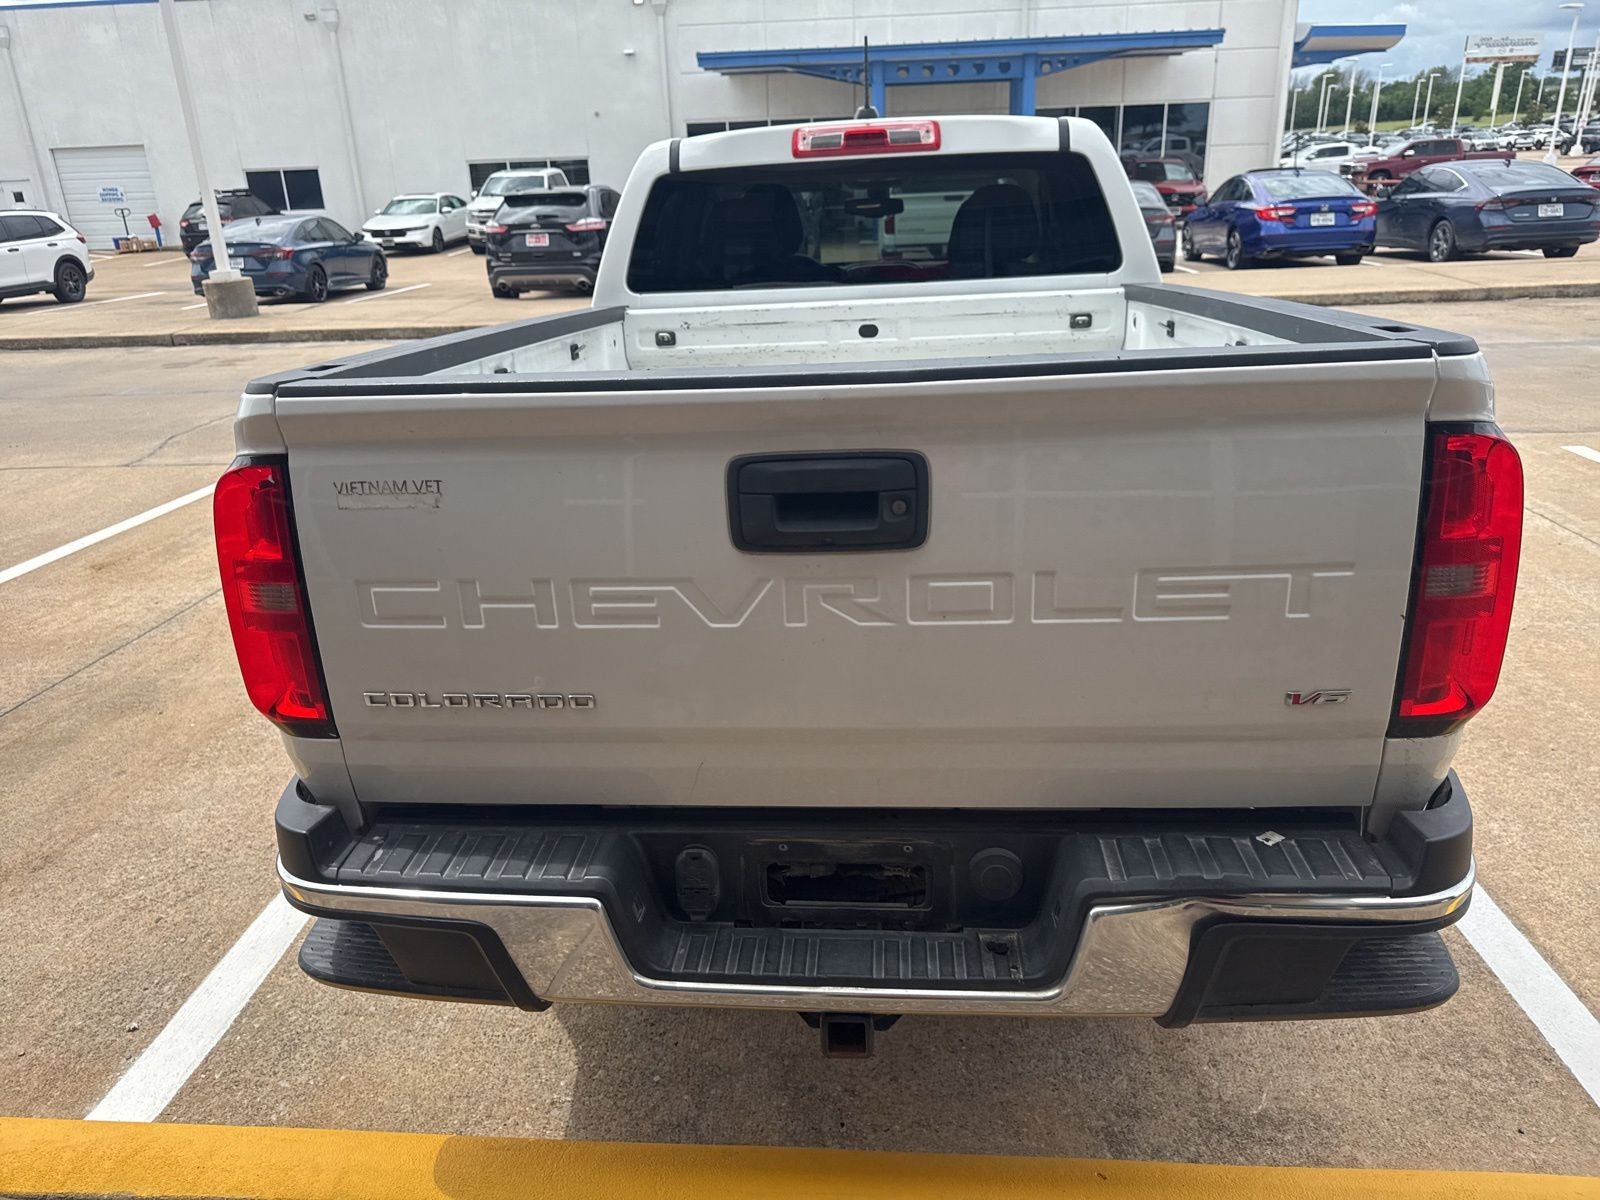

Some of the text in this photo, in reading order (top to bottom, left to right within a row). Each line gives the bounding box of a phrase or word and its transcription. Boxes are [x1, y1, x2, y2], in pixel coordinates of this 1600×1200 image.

[333, 479, 442, 495] VIETNAM VET
[354, 562, 1356, 629] CHEVROLET
[363, 692, 595, 709] COLORADO
[1285, 690, 1352, 707] V6
